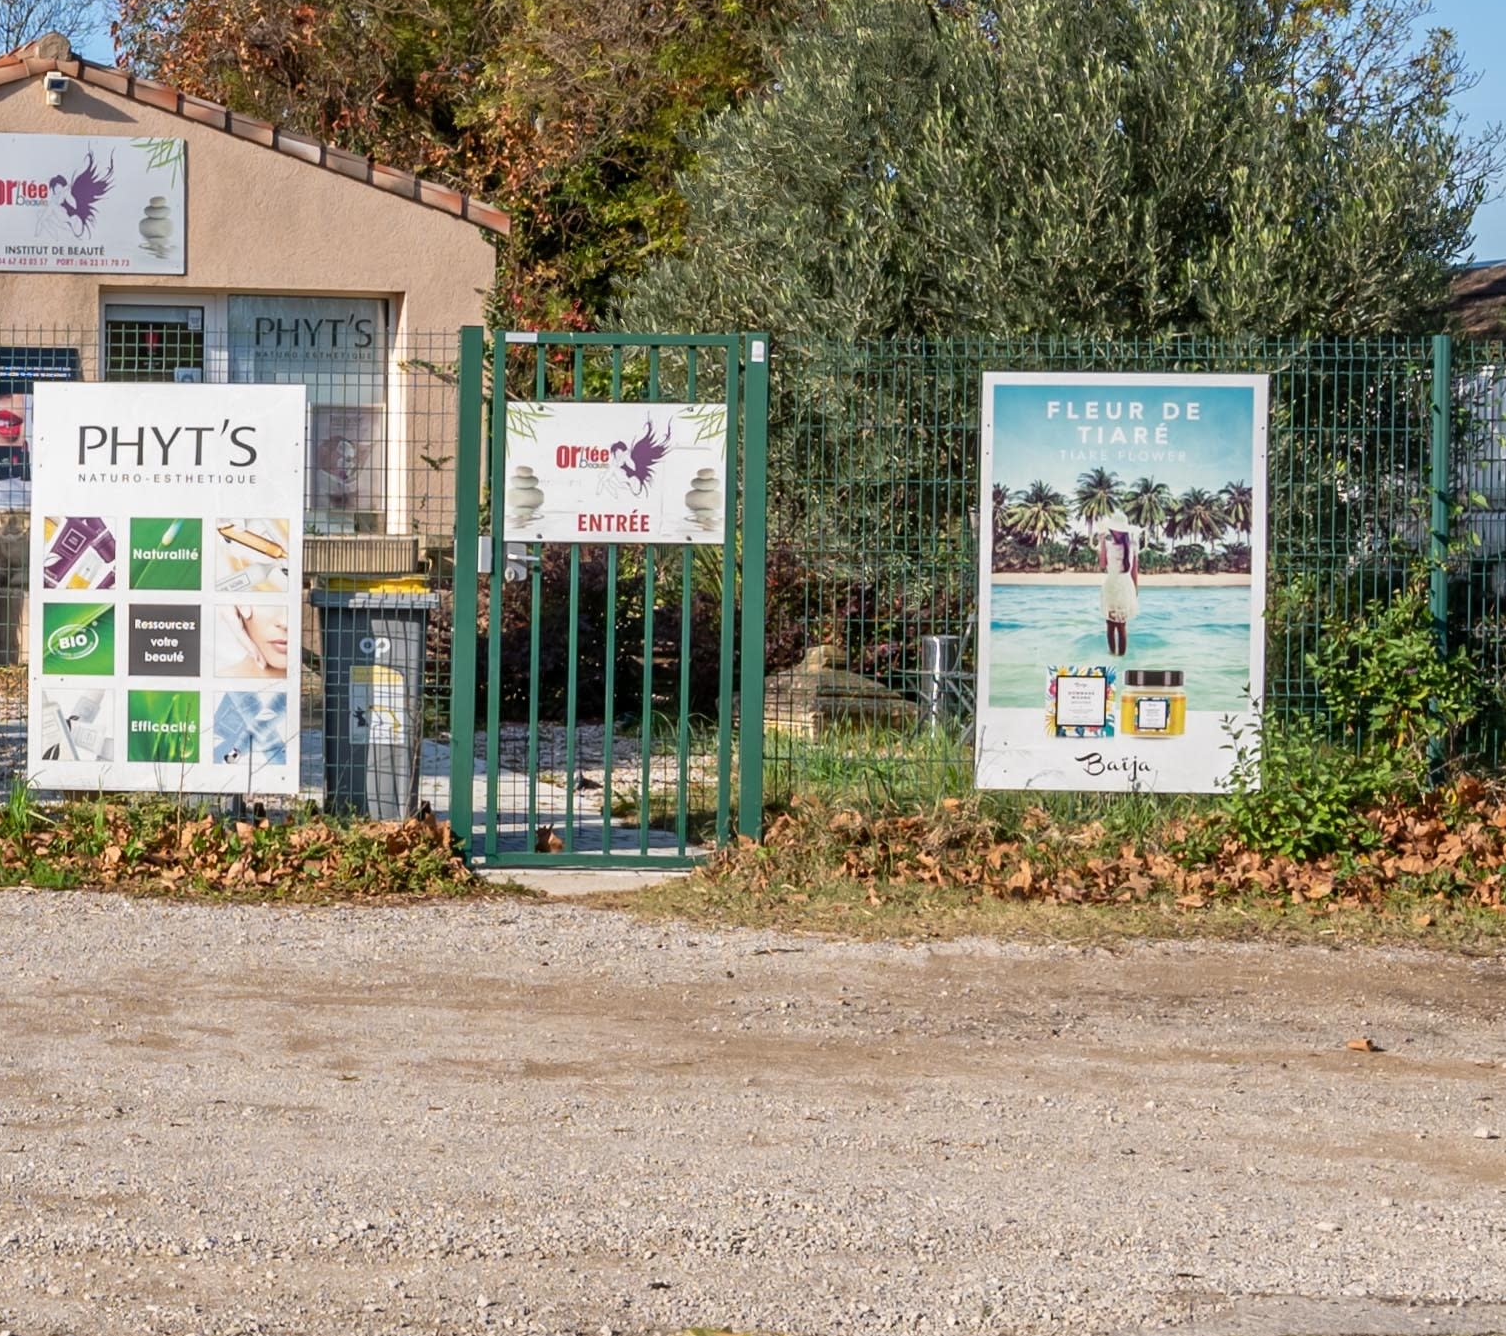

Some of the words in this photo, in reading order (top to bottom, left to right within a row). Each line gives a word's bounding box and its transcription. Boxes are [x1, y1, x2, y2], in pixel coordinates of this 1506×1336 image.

[5, 246, 48, 255] INSTITUT
[52, 247, 64, 255] DE
[68, 245, 106, 256] BEAUTÉ
[255, 314, 372, 348] PHYT'S
[1047, 401, 1144, 420] FLEUR
[1163, 402, 1200, 420] DE
[1077, 423, 1168, 444] TIARÉ
[78, 419, 257, 467] PHYT'S
[1118, 449, 1186, 462] FLOWER
[78, 473, 257, 484] NATURO-ESTHETIQUE
[578, 509, 650, 532] ENTRÉE
[133, 547, 199, 561] Naturalité
[134, 619, 196, 631] Ressourcez
[59, 634, 88, 650] BIO
[150, 637, 179, 649] votre
[144, 652, 185, 664] beauté
[131, 720, 197, 734] Efficacité
[1074, 752, 1151, 782] Baïja
